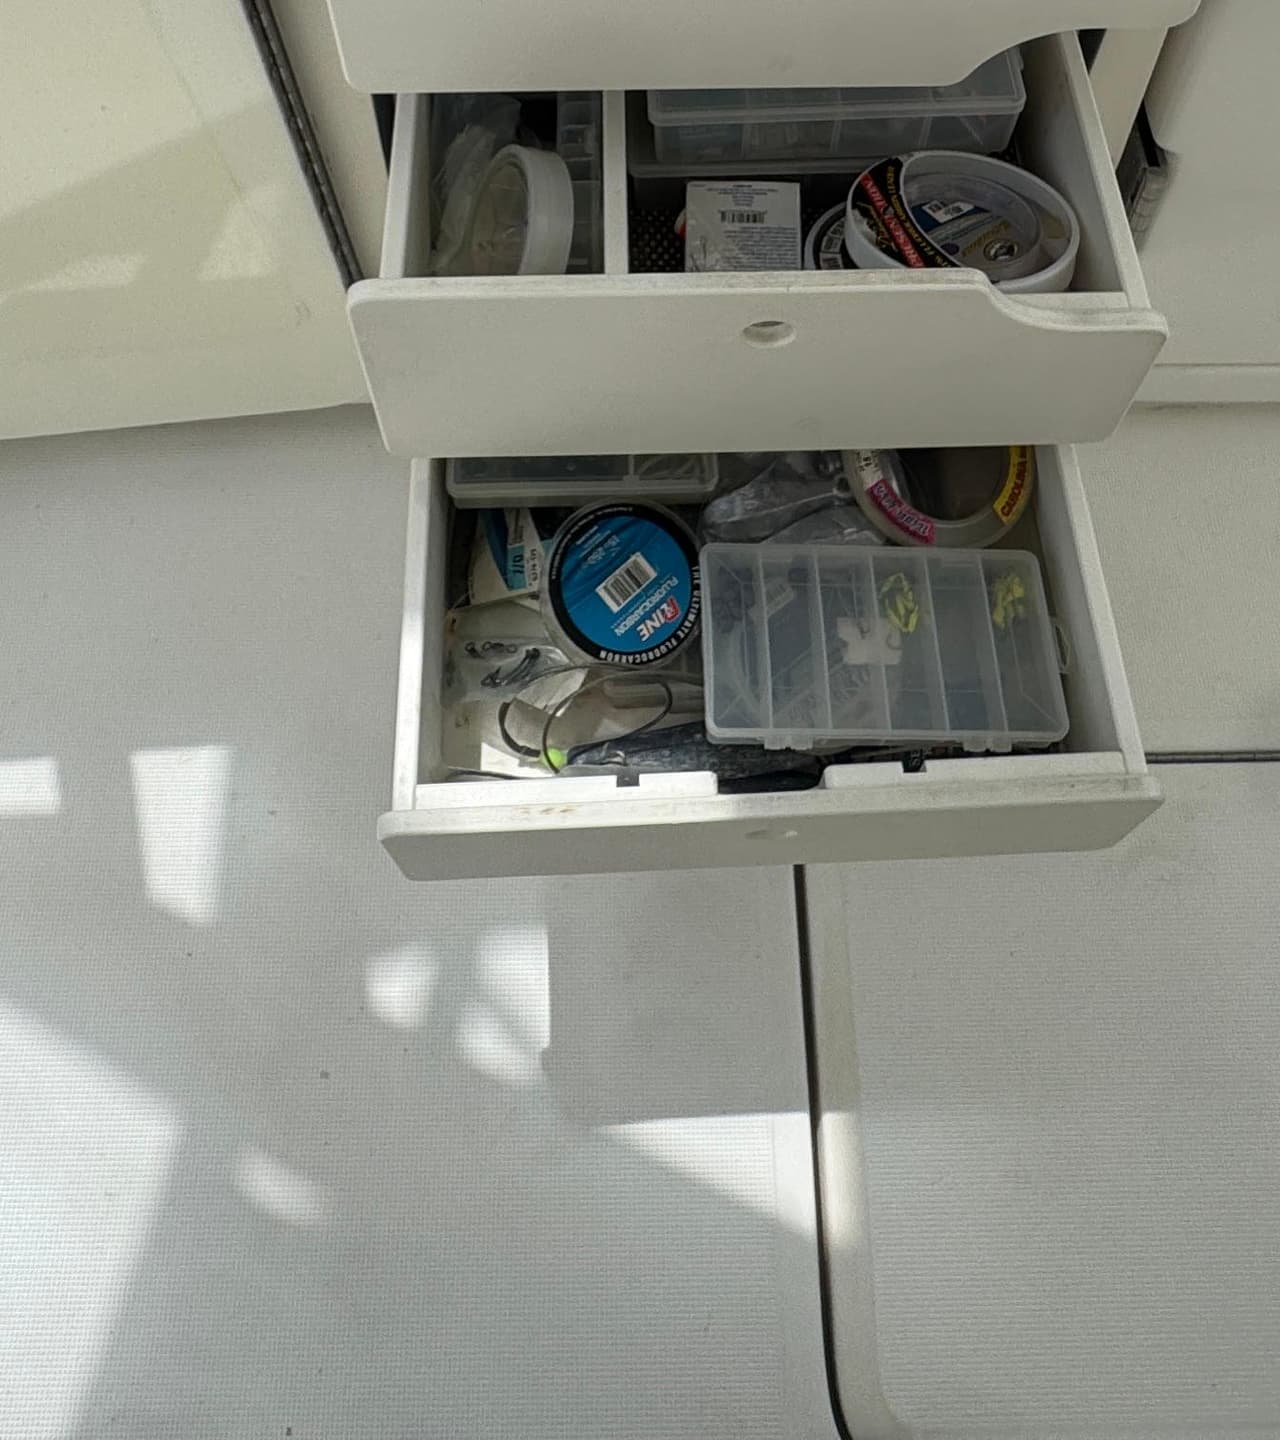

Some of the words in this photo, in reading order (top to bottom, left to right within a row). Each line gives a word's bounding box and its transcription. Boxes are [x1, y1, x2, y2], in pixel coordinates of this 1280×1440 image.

[613, 575, 679, 638] FLUOROCARBON
[679, 590, 701, 639] ULTIMATE
[599, 639, 679, 665] FLUOROCARBON
